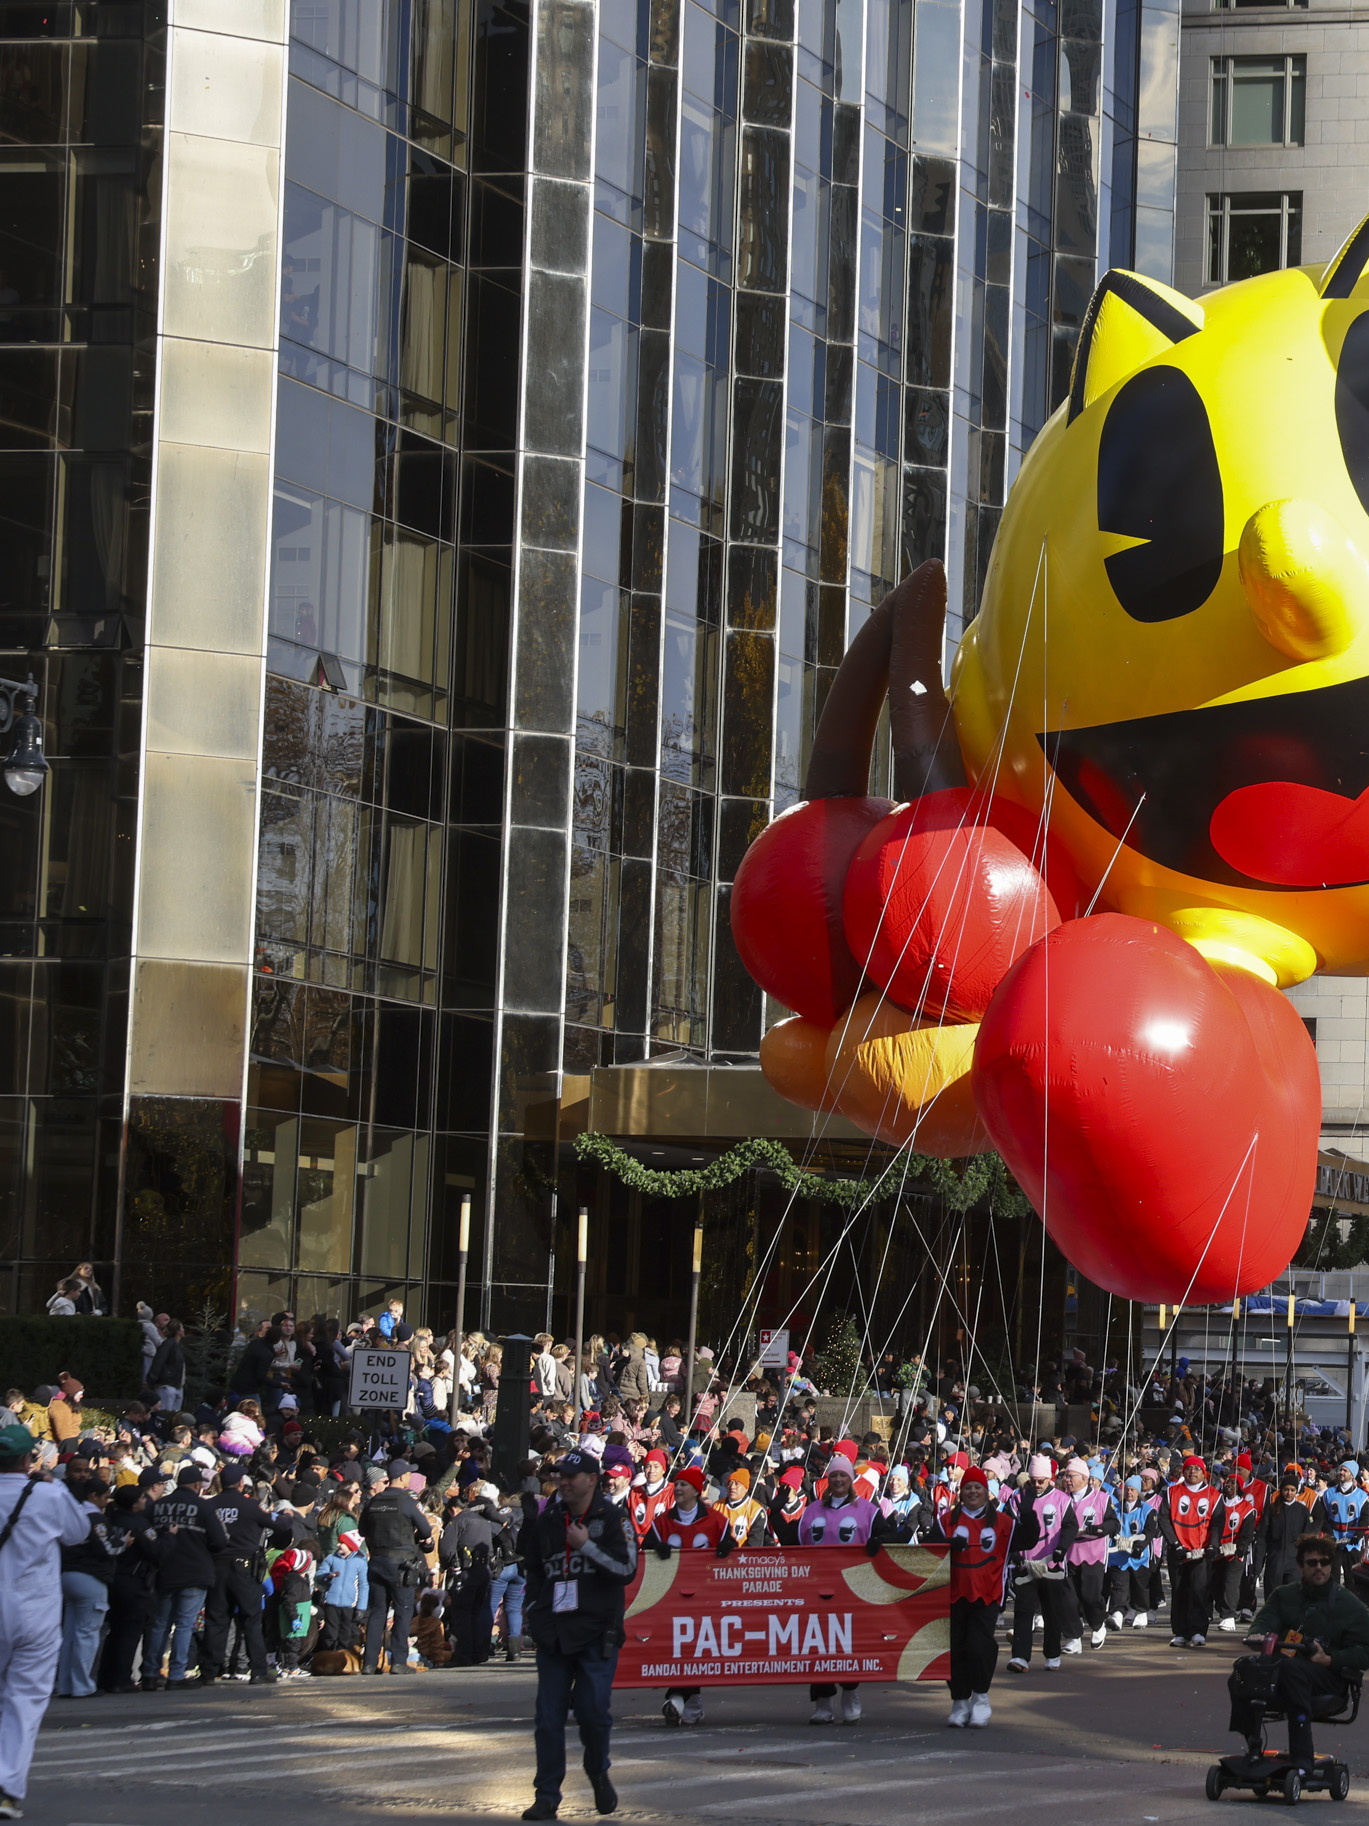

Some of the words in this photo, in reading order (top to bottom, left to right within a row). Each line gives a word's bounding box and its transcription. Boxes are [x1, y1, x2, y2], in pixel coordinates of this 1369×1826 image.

[367, 1355, 396, 1367] END
[362, 1372, 398, 1385] TOLL
[359, 1390, 399, 1403] ZONE
[154, 1503, 199, 1516] NYPD
[153, 1515, 197, 1525] POLICE
[748, 1552, 786, 1565] macy's
[713, 1566, 788, 1579] THANKSGIVING
[791, 1565, 811, 1577] DAY
[742, 1580, 783, 1593] PARADE
[720, 1598, 805, 1607] PRESENTS
[672, 1613, 853, 1658] PAC-MAN
[641, 1664, 681, 1677] BANDAI
[683, 1662, 721, 1675] NAMCO
[724, 1660, 811, 1674] ENTERTAINMENT
[814, 1659, 860, 1672] AMERICA
[862, 1659, 883, 1671] INC.
